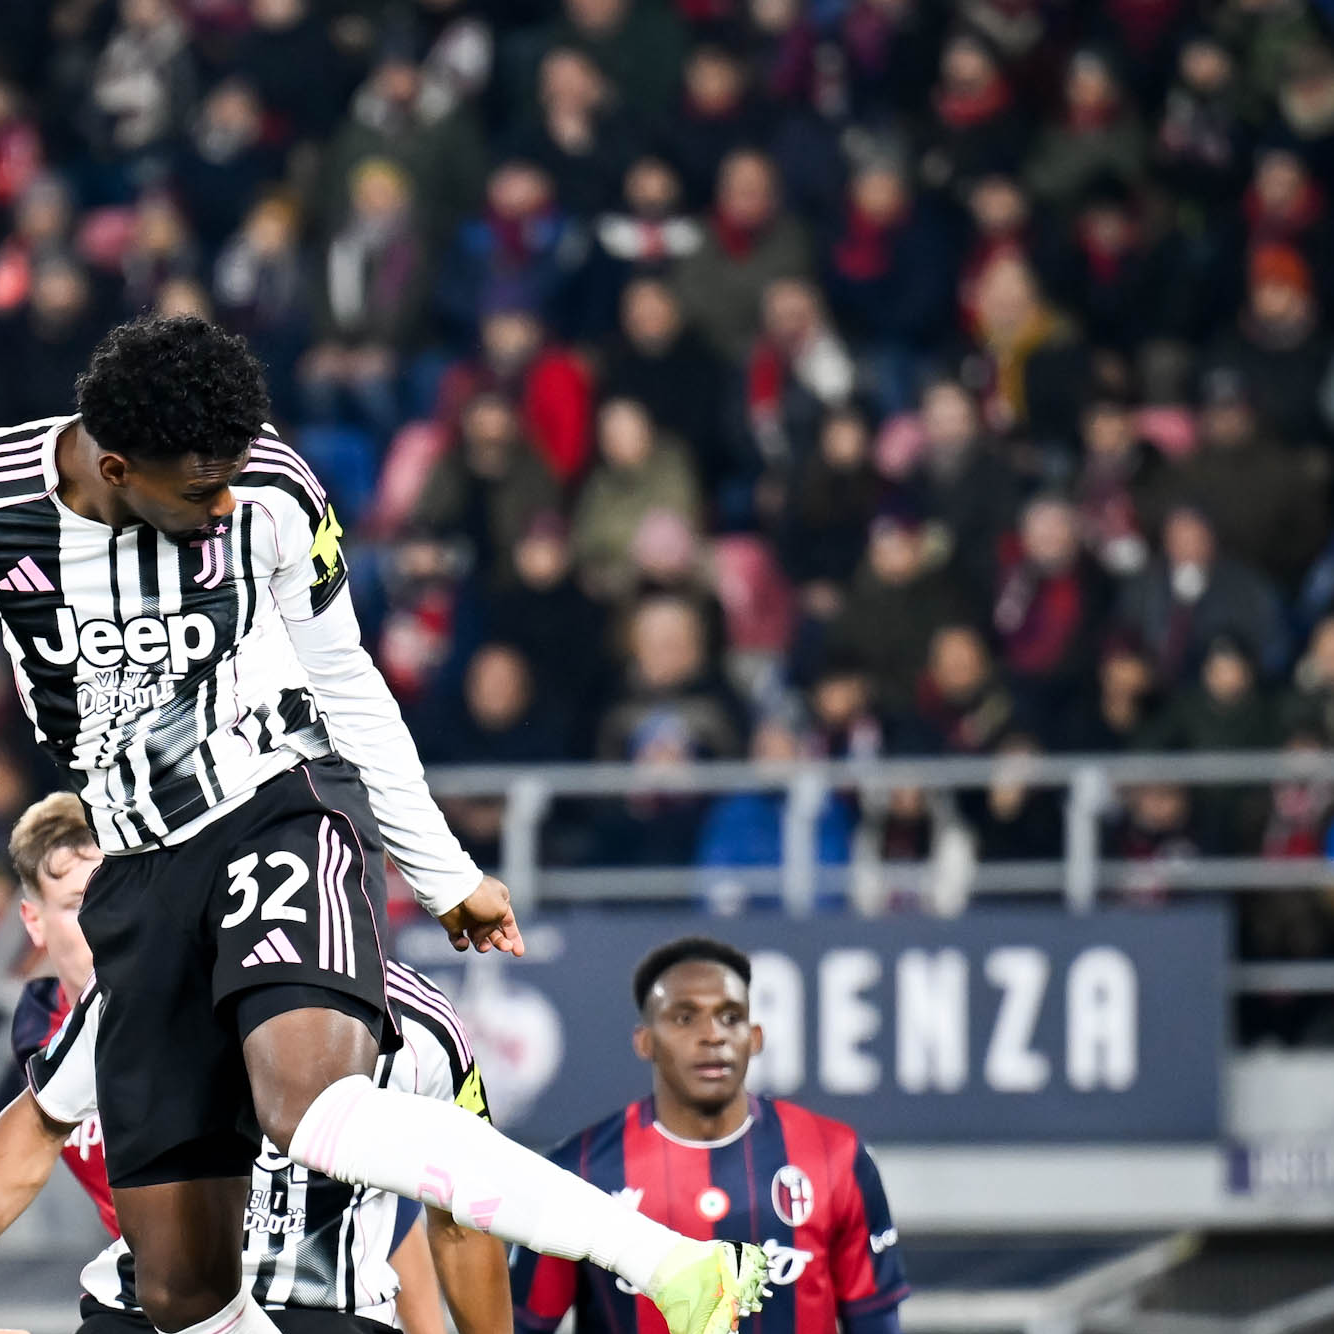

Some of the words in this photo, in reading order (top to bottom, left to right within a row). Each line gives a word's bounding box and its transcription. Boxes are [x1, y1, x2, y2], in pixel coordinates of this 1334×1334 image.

[32, 608, 217, 673] Jeep
[221, 851, 310, 929] 32
[745, 945, 1139, 1096] AENZA
